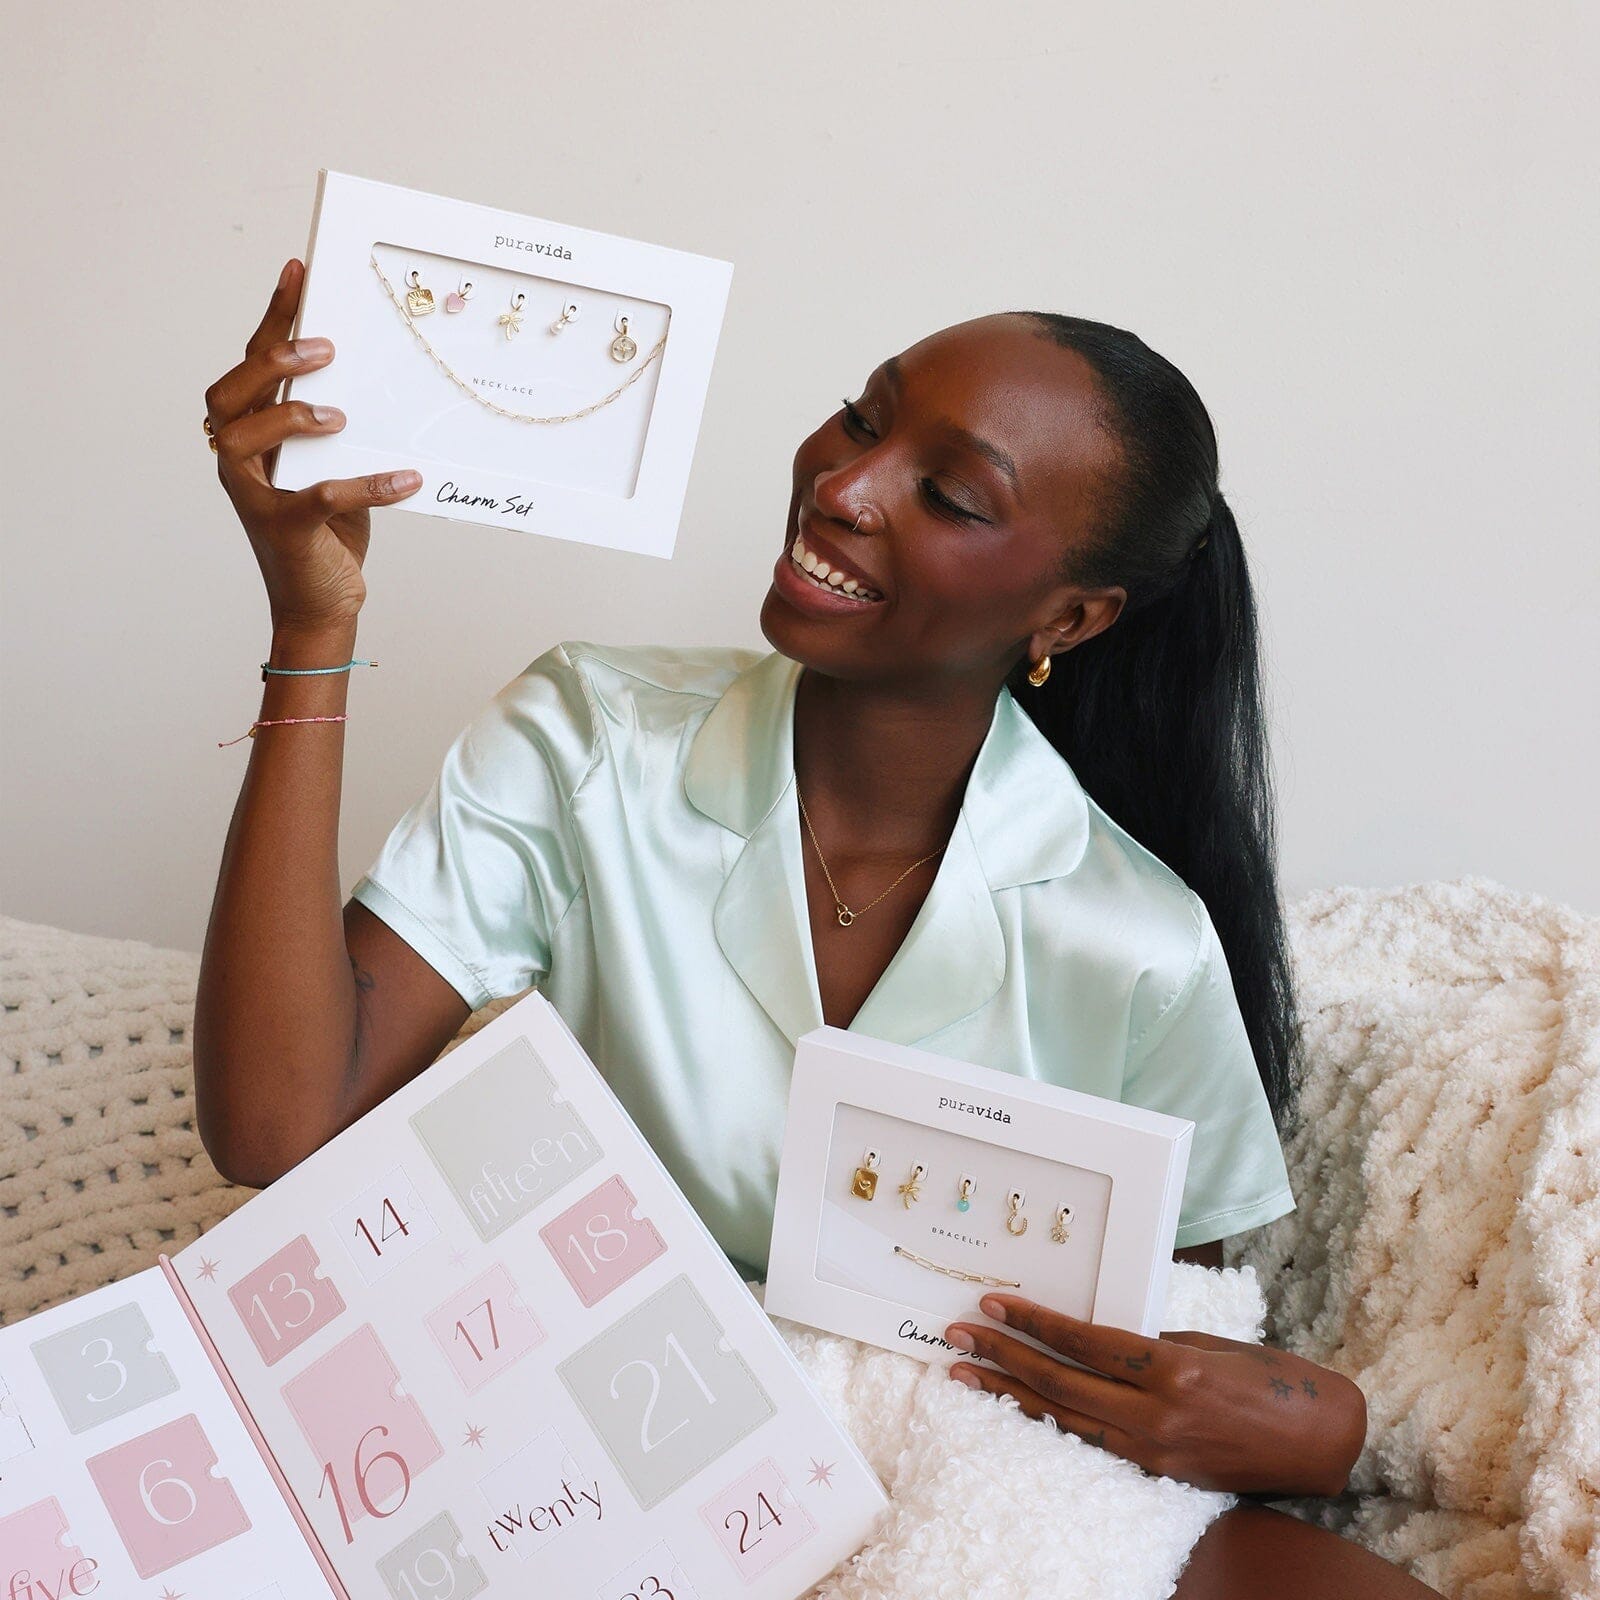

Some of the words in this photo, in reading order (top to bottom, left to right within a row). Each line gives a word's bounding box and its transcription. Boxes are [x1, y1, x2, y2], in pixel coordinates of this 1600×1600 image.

[494, 233, 573, 261] puravida
[472, 377, 534, 395] NECKLACE
[436, 481, 498, 510] Charm
[501, 495, 534, 517] Set
[938, 1095, 1012, 1124] puravida
[468, 1131, 589, 1226] fifteen
[354, 1197, 409, 1256] 14
[567, 1213, 629, 1275] 18
[931, 1227, 989, 1248] BRACELET
[250, 1271, 316, 1341] 13
[454, 1298, 500, 1362] 17
[898, 1319, 954, 1350] Charm
[80, 1337, 128, 1402] 3
[609, 1331, 718, 1454] 21
[138, 1458, 198, 1525] 6
[317, 1425, 411, 1544] 16
[486, 1479, 605, 1552] twenty
[725, 1491, 782, 1554] 24
[396, 1548, 457, 1600] 19
